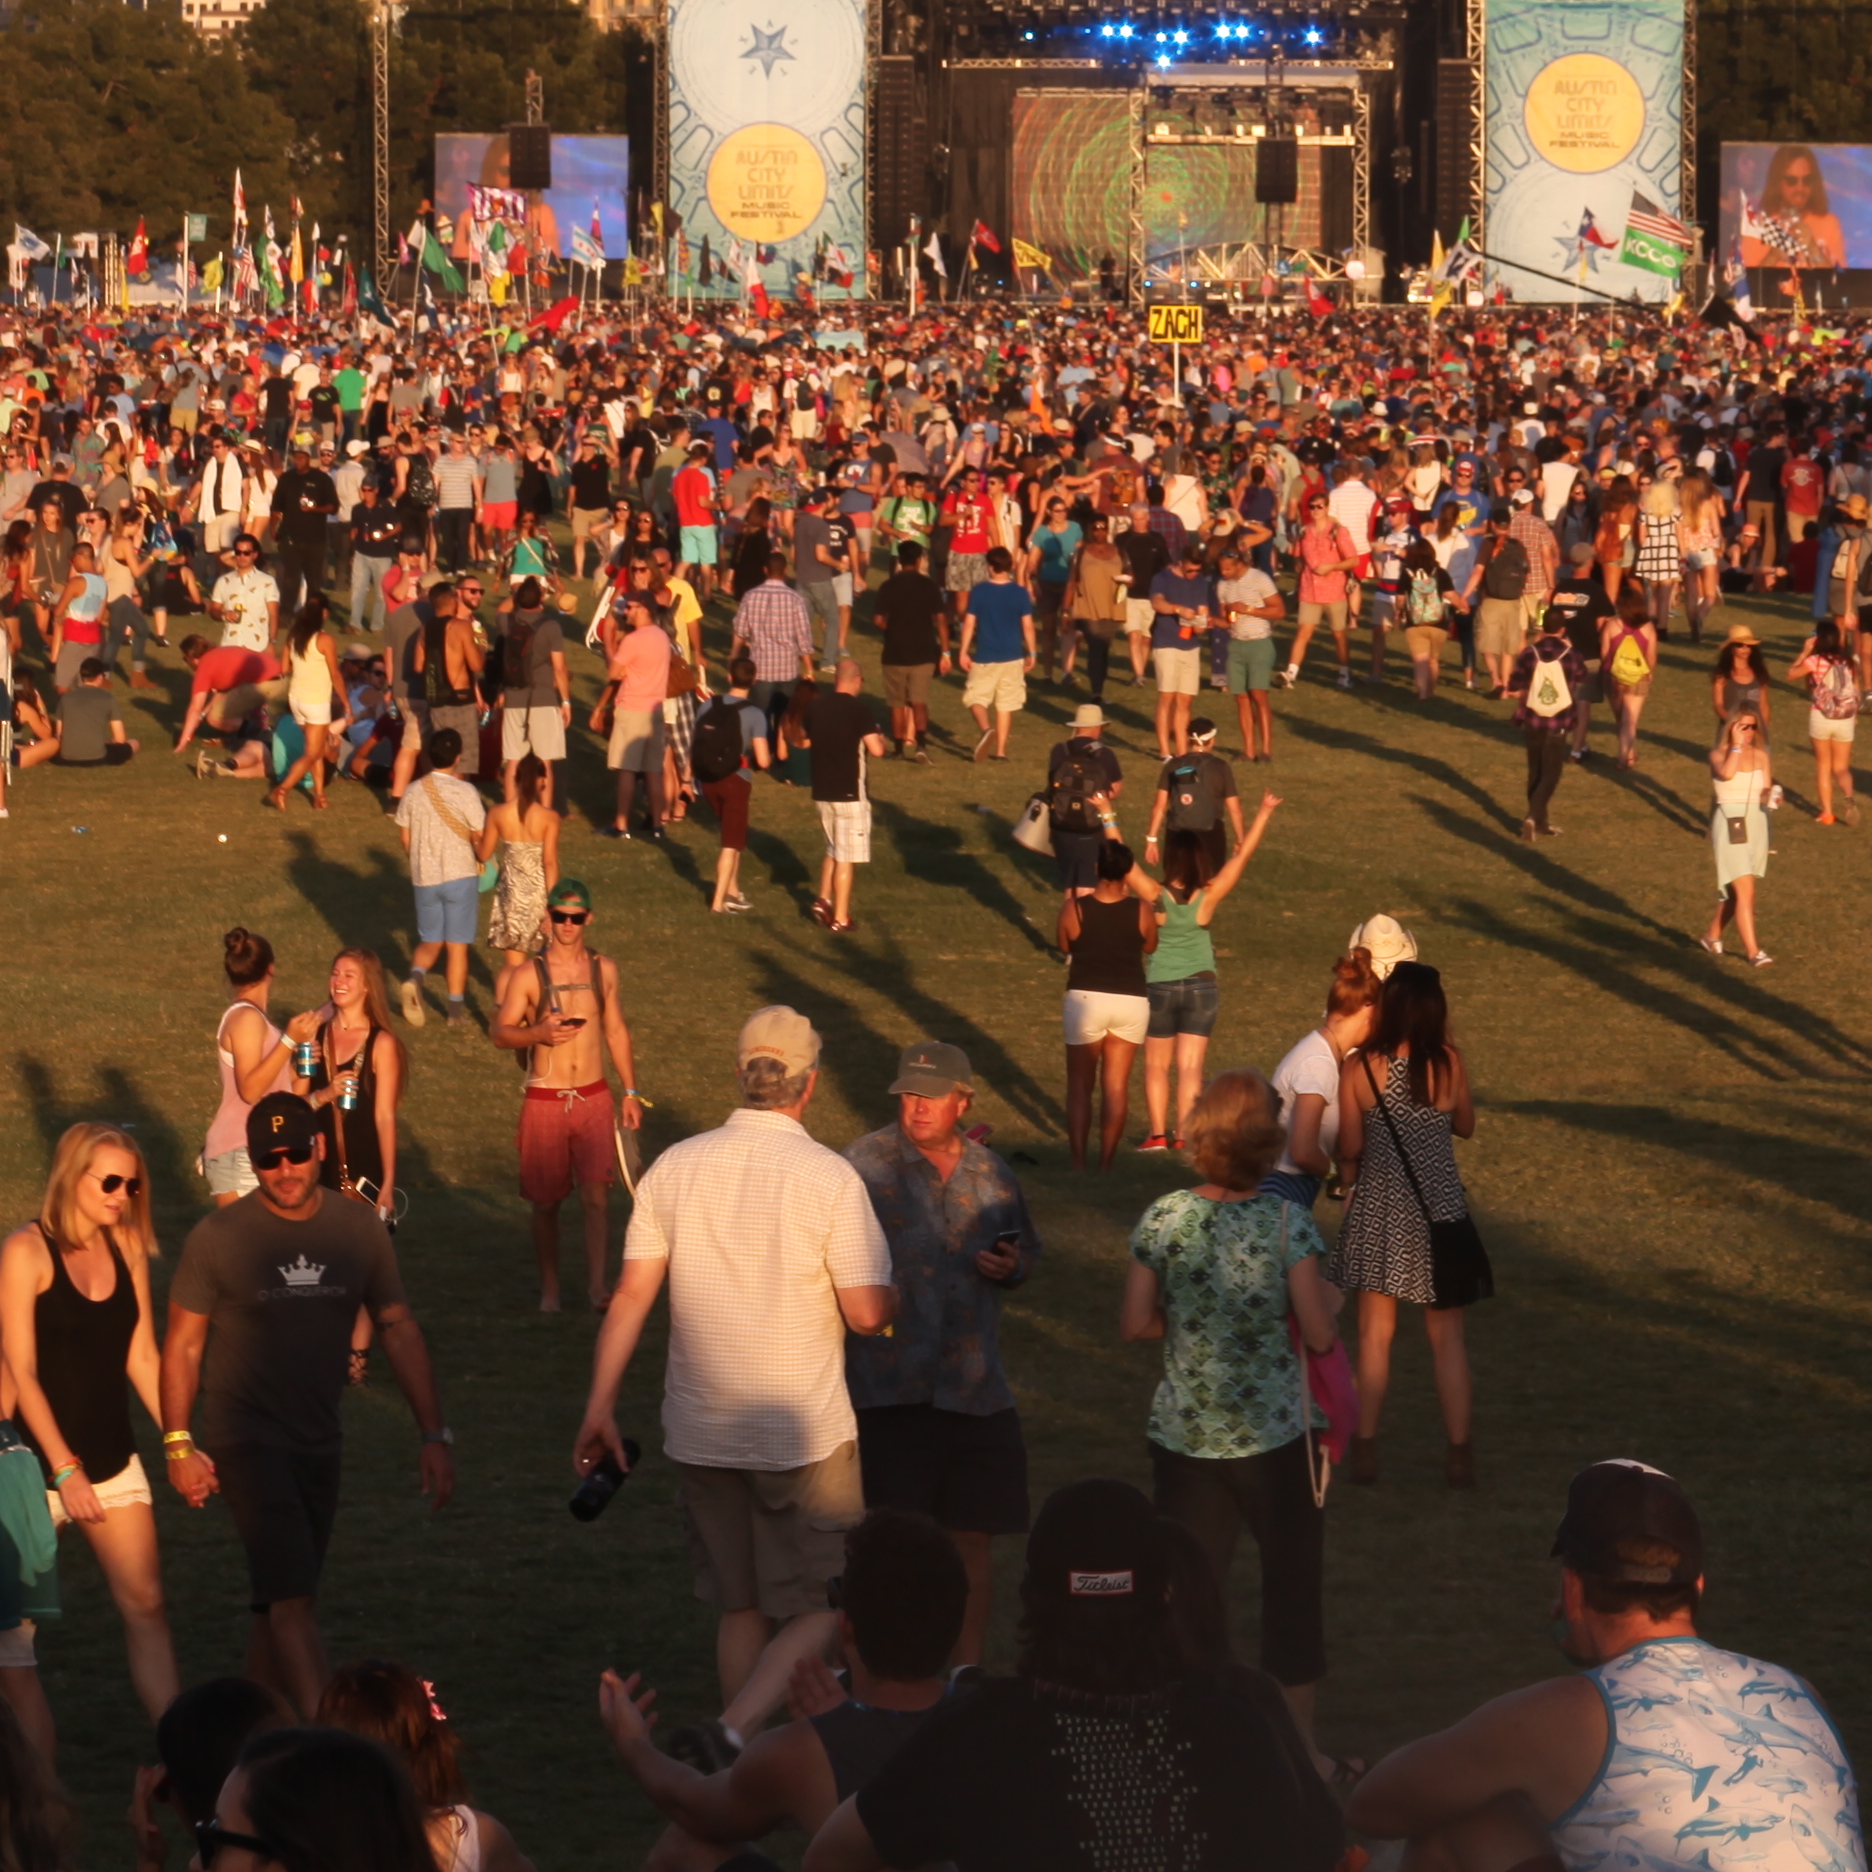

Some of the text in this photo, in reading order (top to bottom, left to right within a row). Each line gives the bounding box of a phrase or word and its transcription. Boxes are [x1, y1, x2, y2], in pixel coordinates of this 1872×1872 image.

[1553, 79, 1618, 95] AUSTIN
[1566, 97, 1604, 112] CITY
[1556, 115, 1615, 129] LIMITS
[1559, 131, 1610, 139] MUSIC
[1548, 140, 1621, 148] FESTIVAL
[736, 150, 798, 165] AUSTIN
[747, 167, 786, 183] CITY
[738, 185, 793, 199] LIMITS
[741, 202, 791, 210] MUSIC
[730, 211, 802, 219] FESTIVAL
[1624, 235, 1678, 269] KCCO
[271, 1115, 285, 1133] P
[1073, 1574, 1130, 1592] Titleist
